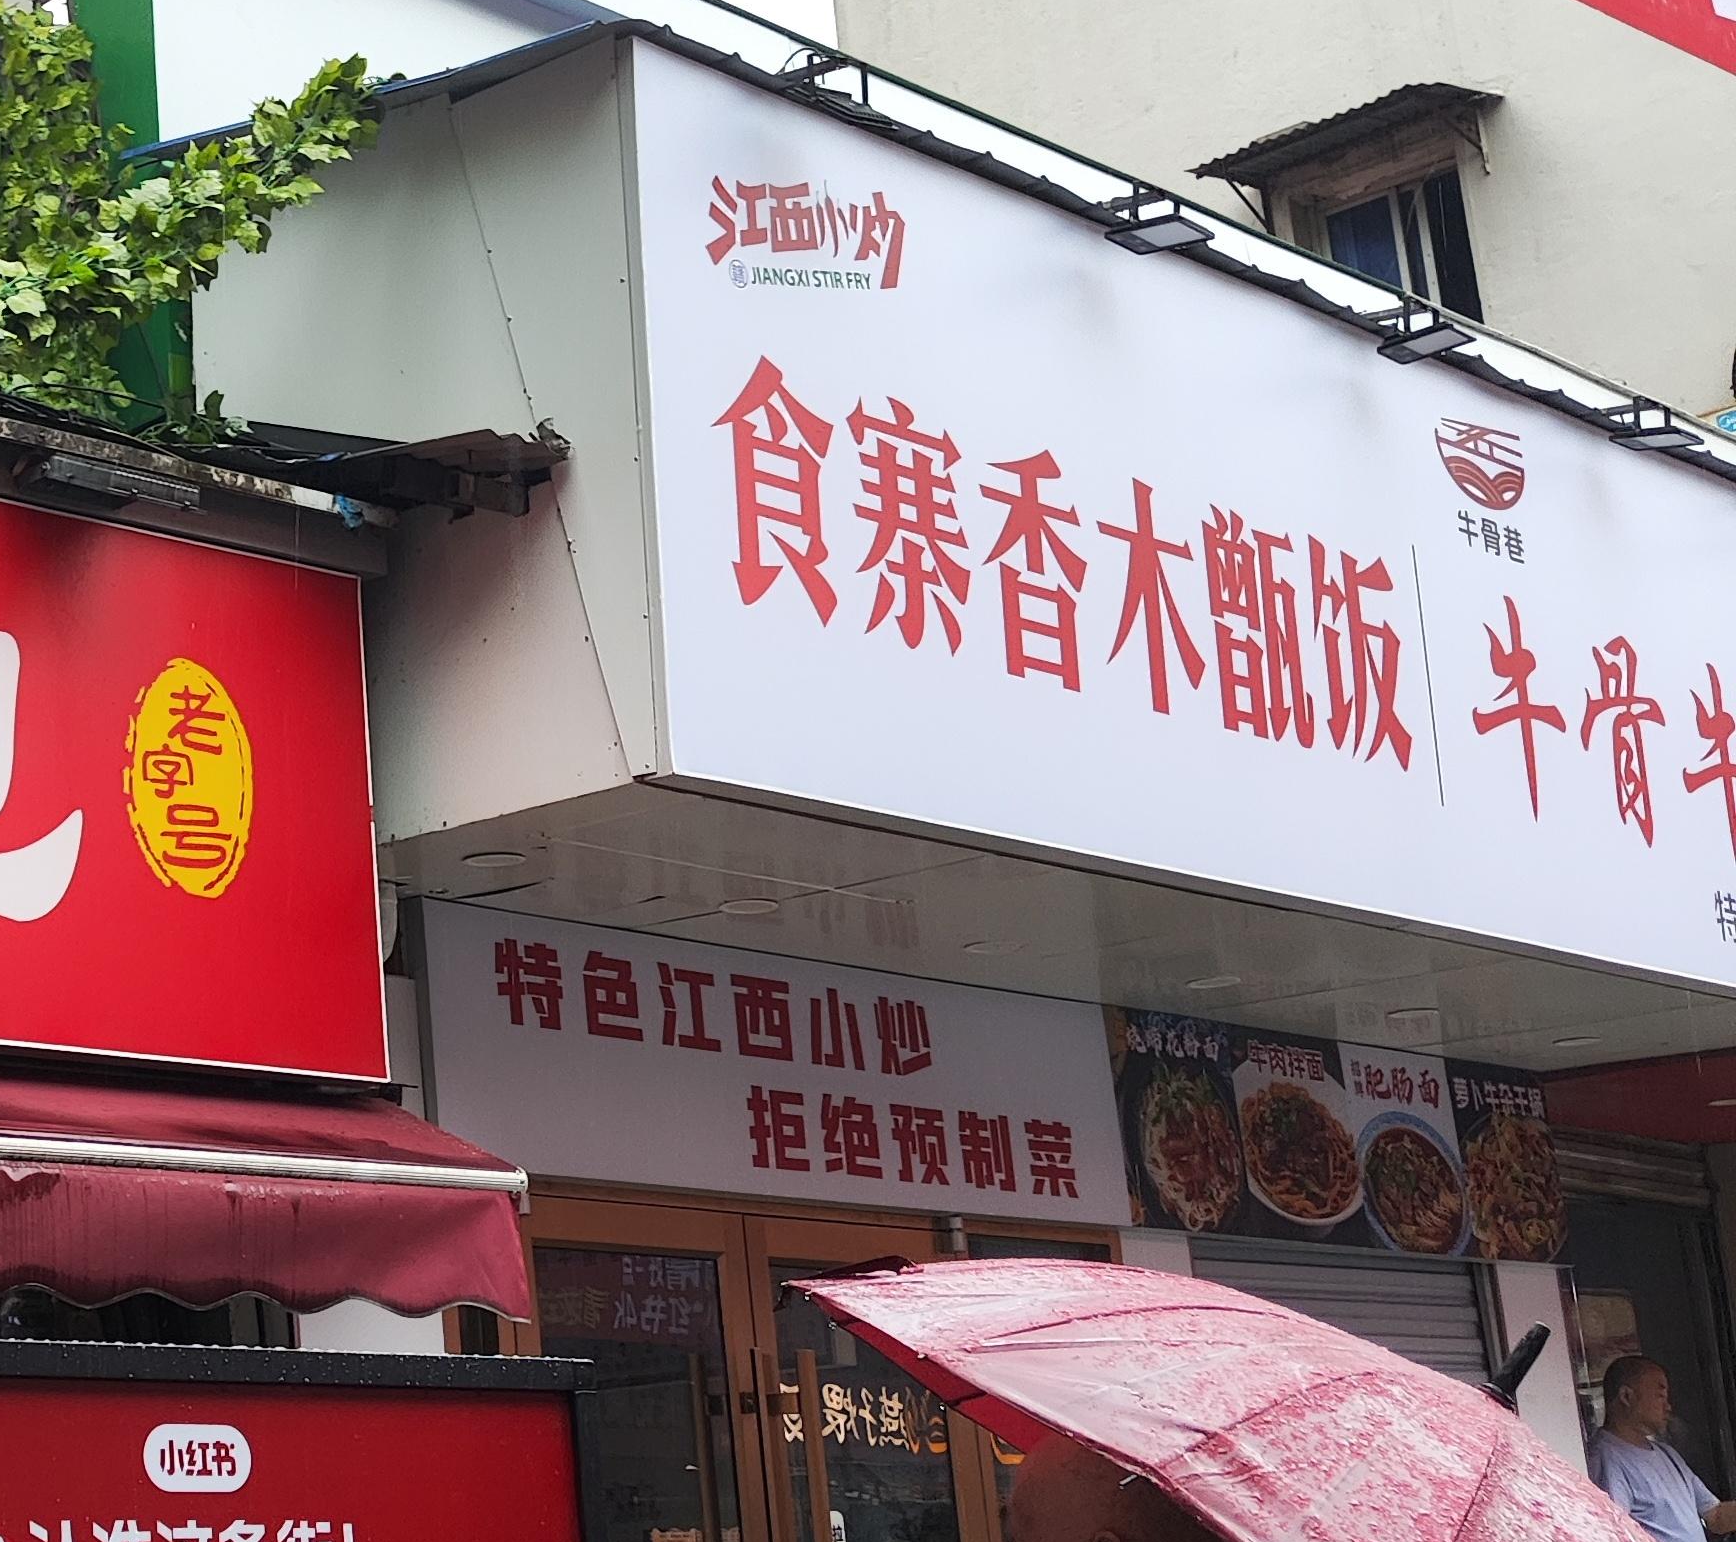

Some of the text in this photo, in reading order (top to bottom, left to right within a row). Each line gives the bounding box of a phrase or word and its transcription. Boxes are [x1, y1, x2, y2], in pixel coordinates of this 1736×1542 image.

[751, 267, 811, 287] JIANGXI
[813, 270, 845, 289] STIR
[847, 272, 871, 290] FRY
[714, 355, 1413, 771] 食寨香木甑饭
[1458, 510, 1524, 564] 牛骨巷
[142, 684, 232, 868] 老字号
[493, 938, 932, 1075] 特色江西小炒
[1364, 1063, 1439, 1109] 肥肠面
[747, 1085, 1080, 1199] 拒绝预制菜
[160, 1439, 236, 1477] 小红书
